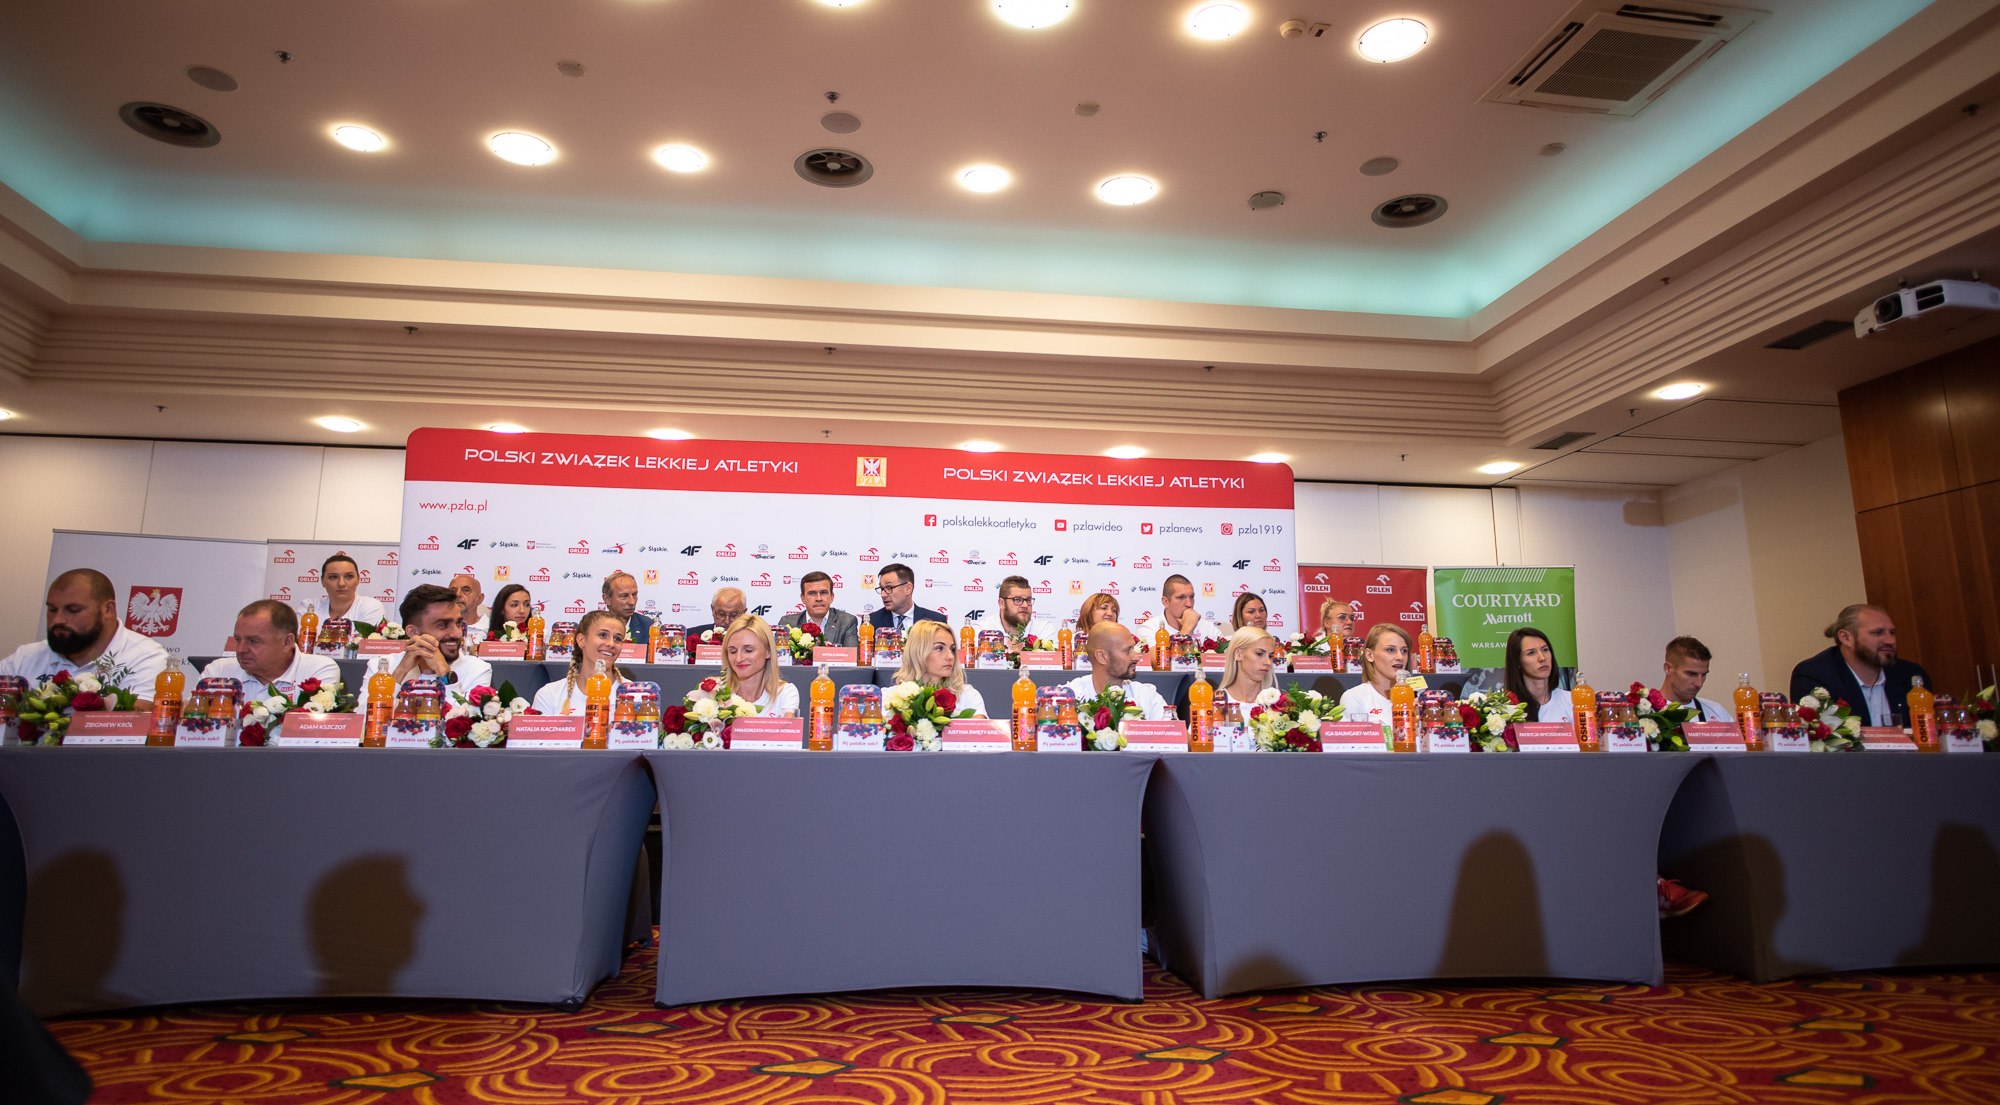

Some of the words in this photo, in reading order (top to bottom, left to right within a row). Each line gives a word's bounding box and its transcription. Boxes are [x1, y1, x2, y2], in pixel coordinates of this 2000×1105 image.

[464, 448, 536, 464] POLSKI
[634, 456, 710, 471] LEKKIEJ
[714, 459, 799, 473] ATLETYKI
[857, 475, 886, 486] PZLA
[943, 467, 1008, 482] POLSKI
[1097, 474, 1166, 487] LEKKIEJ
[1169, 476, 1245, 489] ATLETYKI
[419, 499, 488, 514] www.pzla.pl
[942, 515, 1037, 531] polskalekkoatletyka
[1073, 520, 1123, 533] pzlawideo
[1159, 522, 1203, 535] pzlanews
[1238, 524, 1283, 537] pzla1919
[457, 539, 479, 550] 4F
[681, 546, 702, 556] 4F
[1034, 555, 1053, 566] 4F
[1232, 560, 1251, 570] 4F
[1452, 593, 1561, 608] COURTYARD
[965, 610, 985, 620] 4F
[1482, 612, 1532, 626] Marriott
[1579, 712, 1588, 742] OSHEE
[1919, 714, 1929, 743] OSHEE
